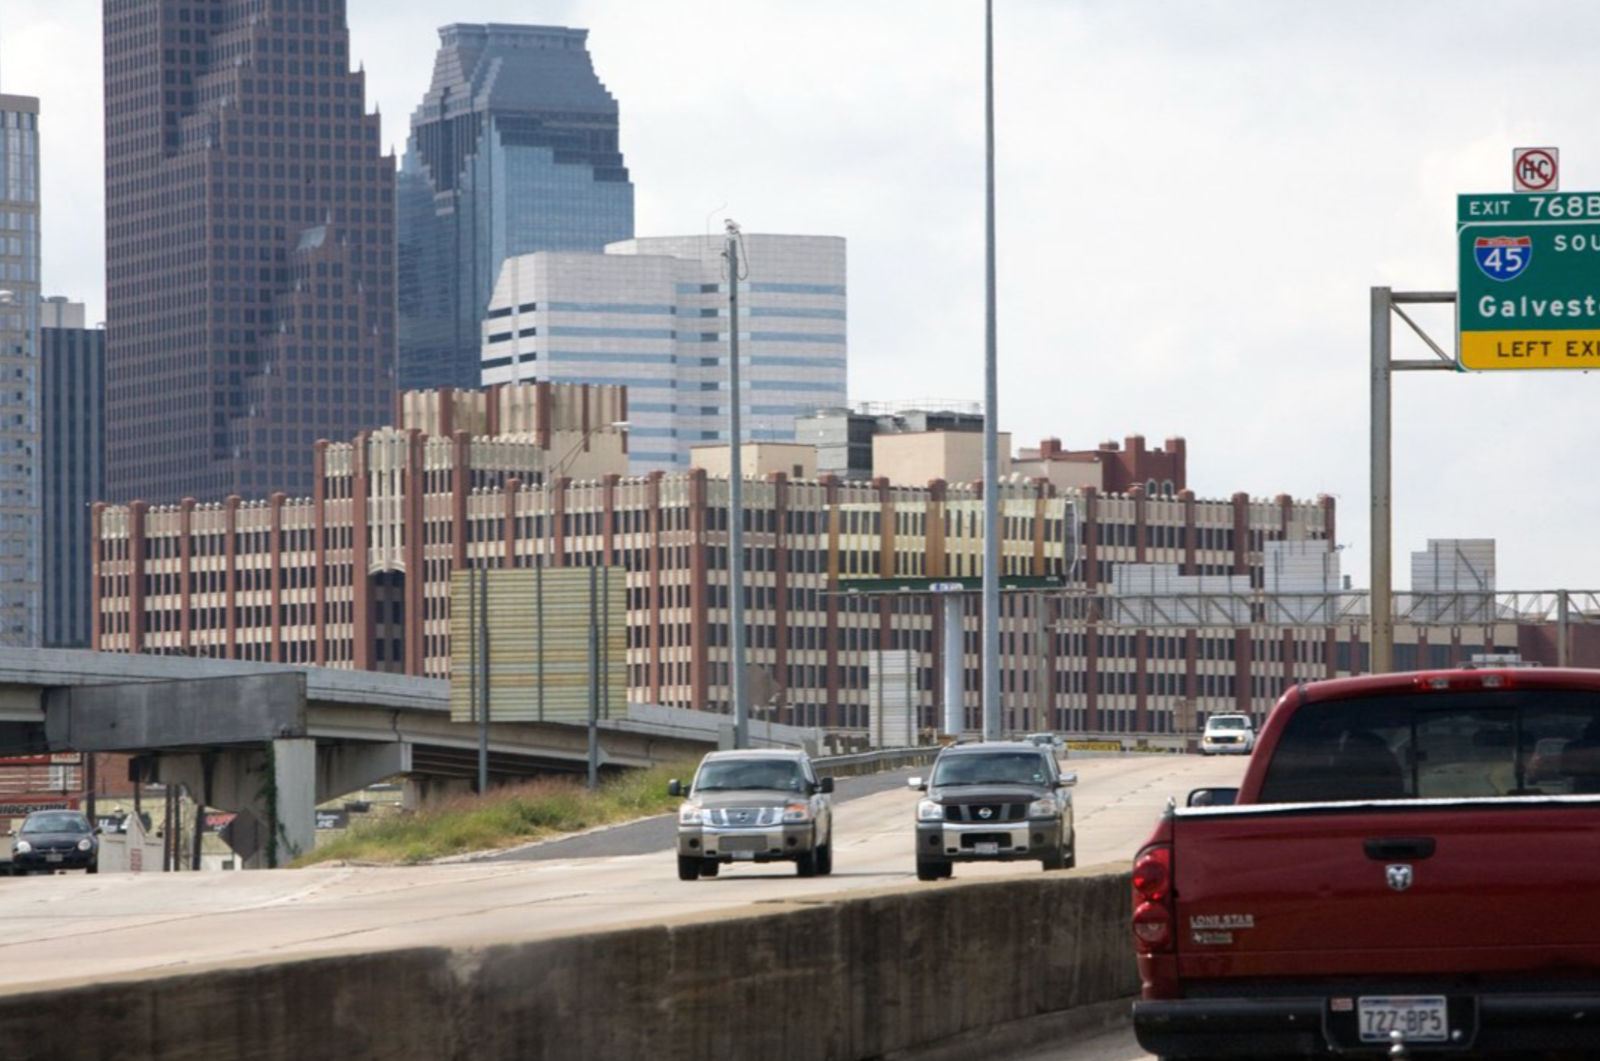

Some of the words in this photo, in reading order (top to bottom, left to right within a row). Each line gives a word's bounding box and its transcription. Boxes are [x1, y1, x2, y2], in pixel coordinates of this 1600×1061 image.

[1469, 200, 1511, 216] EXIT
[1528, 196, 1600, 218] 768B
[1483, 247, 1523, 272] 45
[1478, 294, 1600, 318] Galvest
[1497, 341, 1552, 358] LEFT
[1190, 914, 1220, 929] LONE
[1222, 913, 1254, 928] STAR
